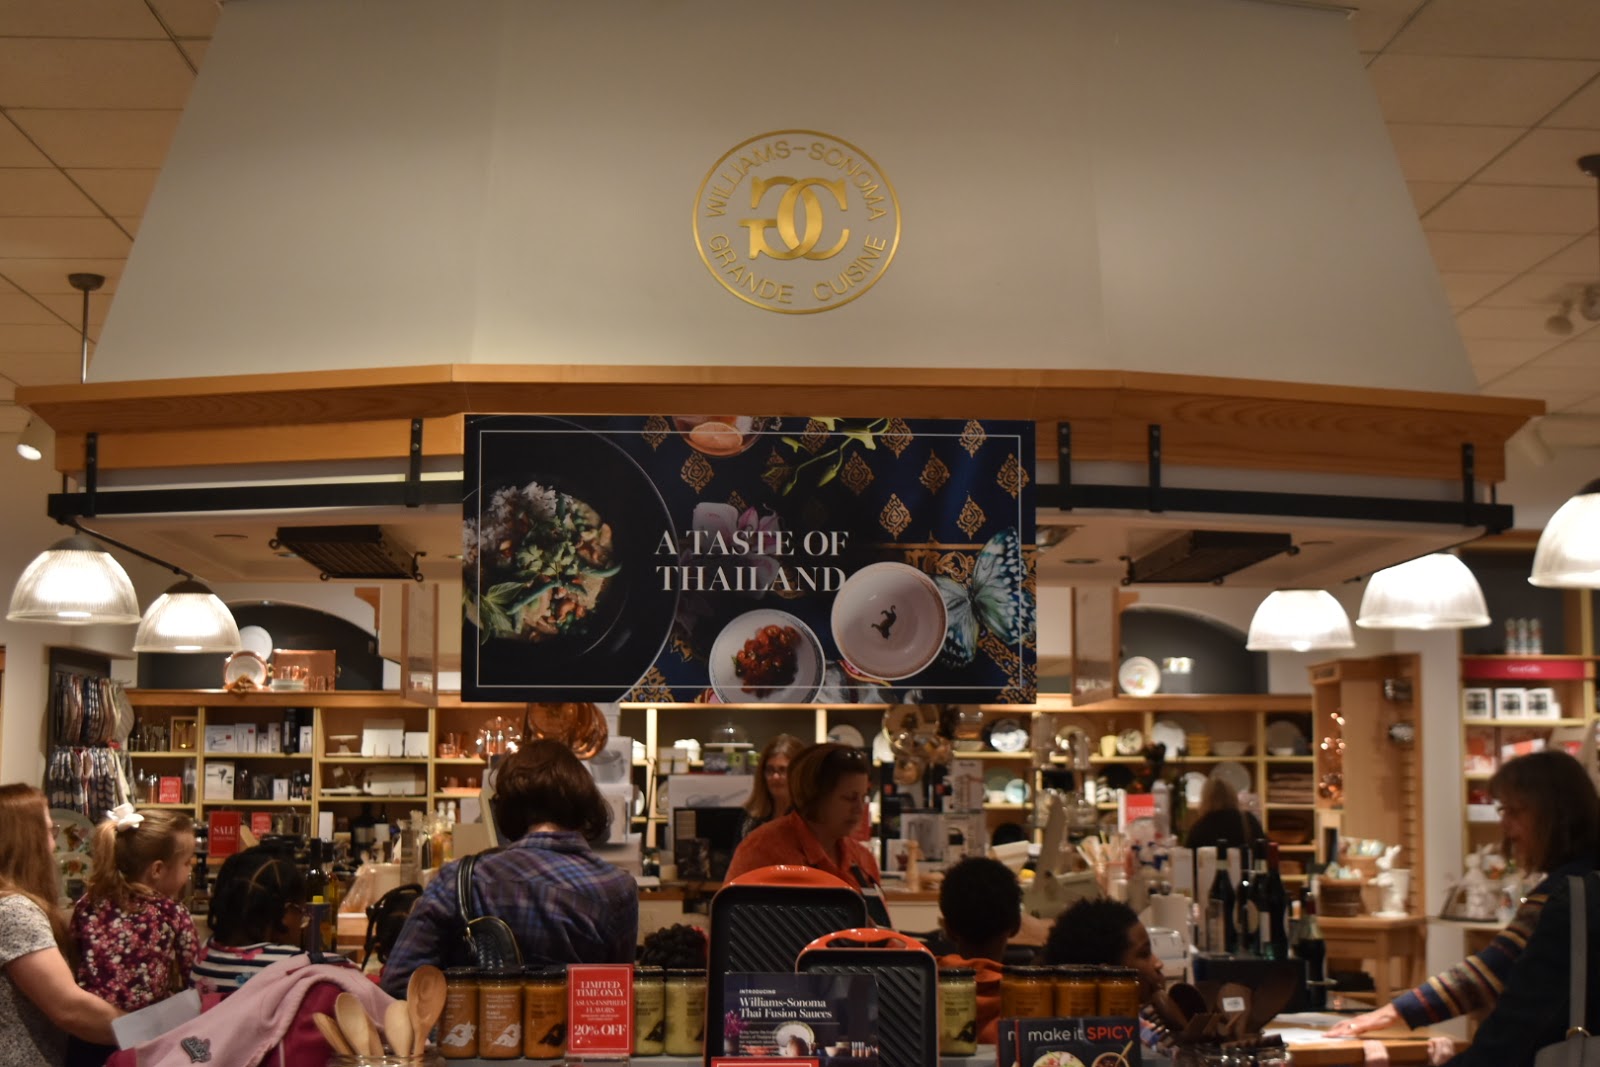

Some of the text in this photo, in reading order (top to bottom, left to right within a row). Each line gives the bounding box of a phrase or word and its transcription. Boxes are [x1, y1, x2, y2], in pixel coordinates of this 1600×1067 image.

[705, 140, 887, 221] WILLIAMS-SONOMA
[709, 234, 886, 304] GRANDE CUISINE
[654, 530, 849, 556] A TASTE OF
[656, 566, 846, 591] THAILAND
[213, 826, 235, 835] SALE
[581, 981, 621, 989] LIMITED
[576, 989, 624, 997] TIME ONLY
[739, 997, 826, 1008] Williams-Sonoma
[739, 1008, 832, 1018] Thai Fusion Sauces
[574, 1024, 627, 1036] 20% OFF
[1028, 1027, 1071, 1041] make
[1073, 1027, 1084, 1041] it
[1087, 1025, 1135, 1040] SPICY
